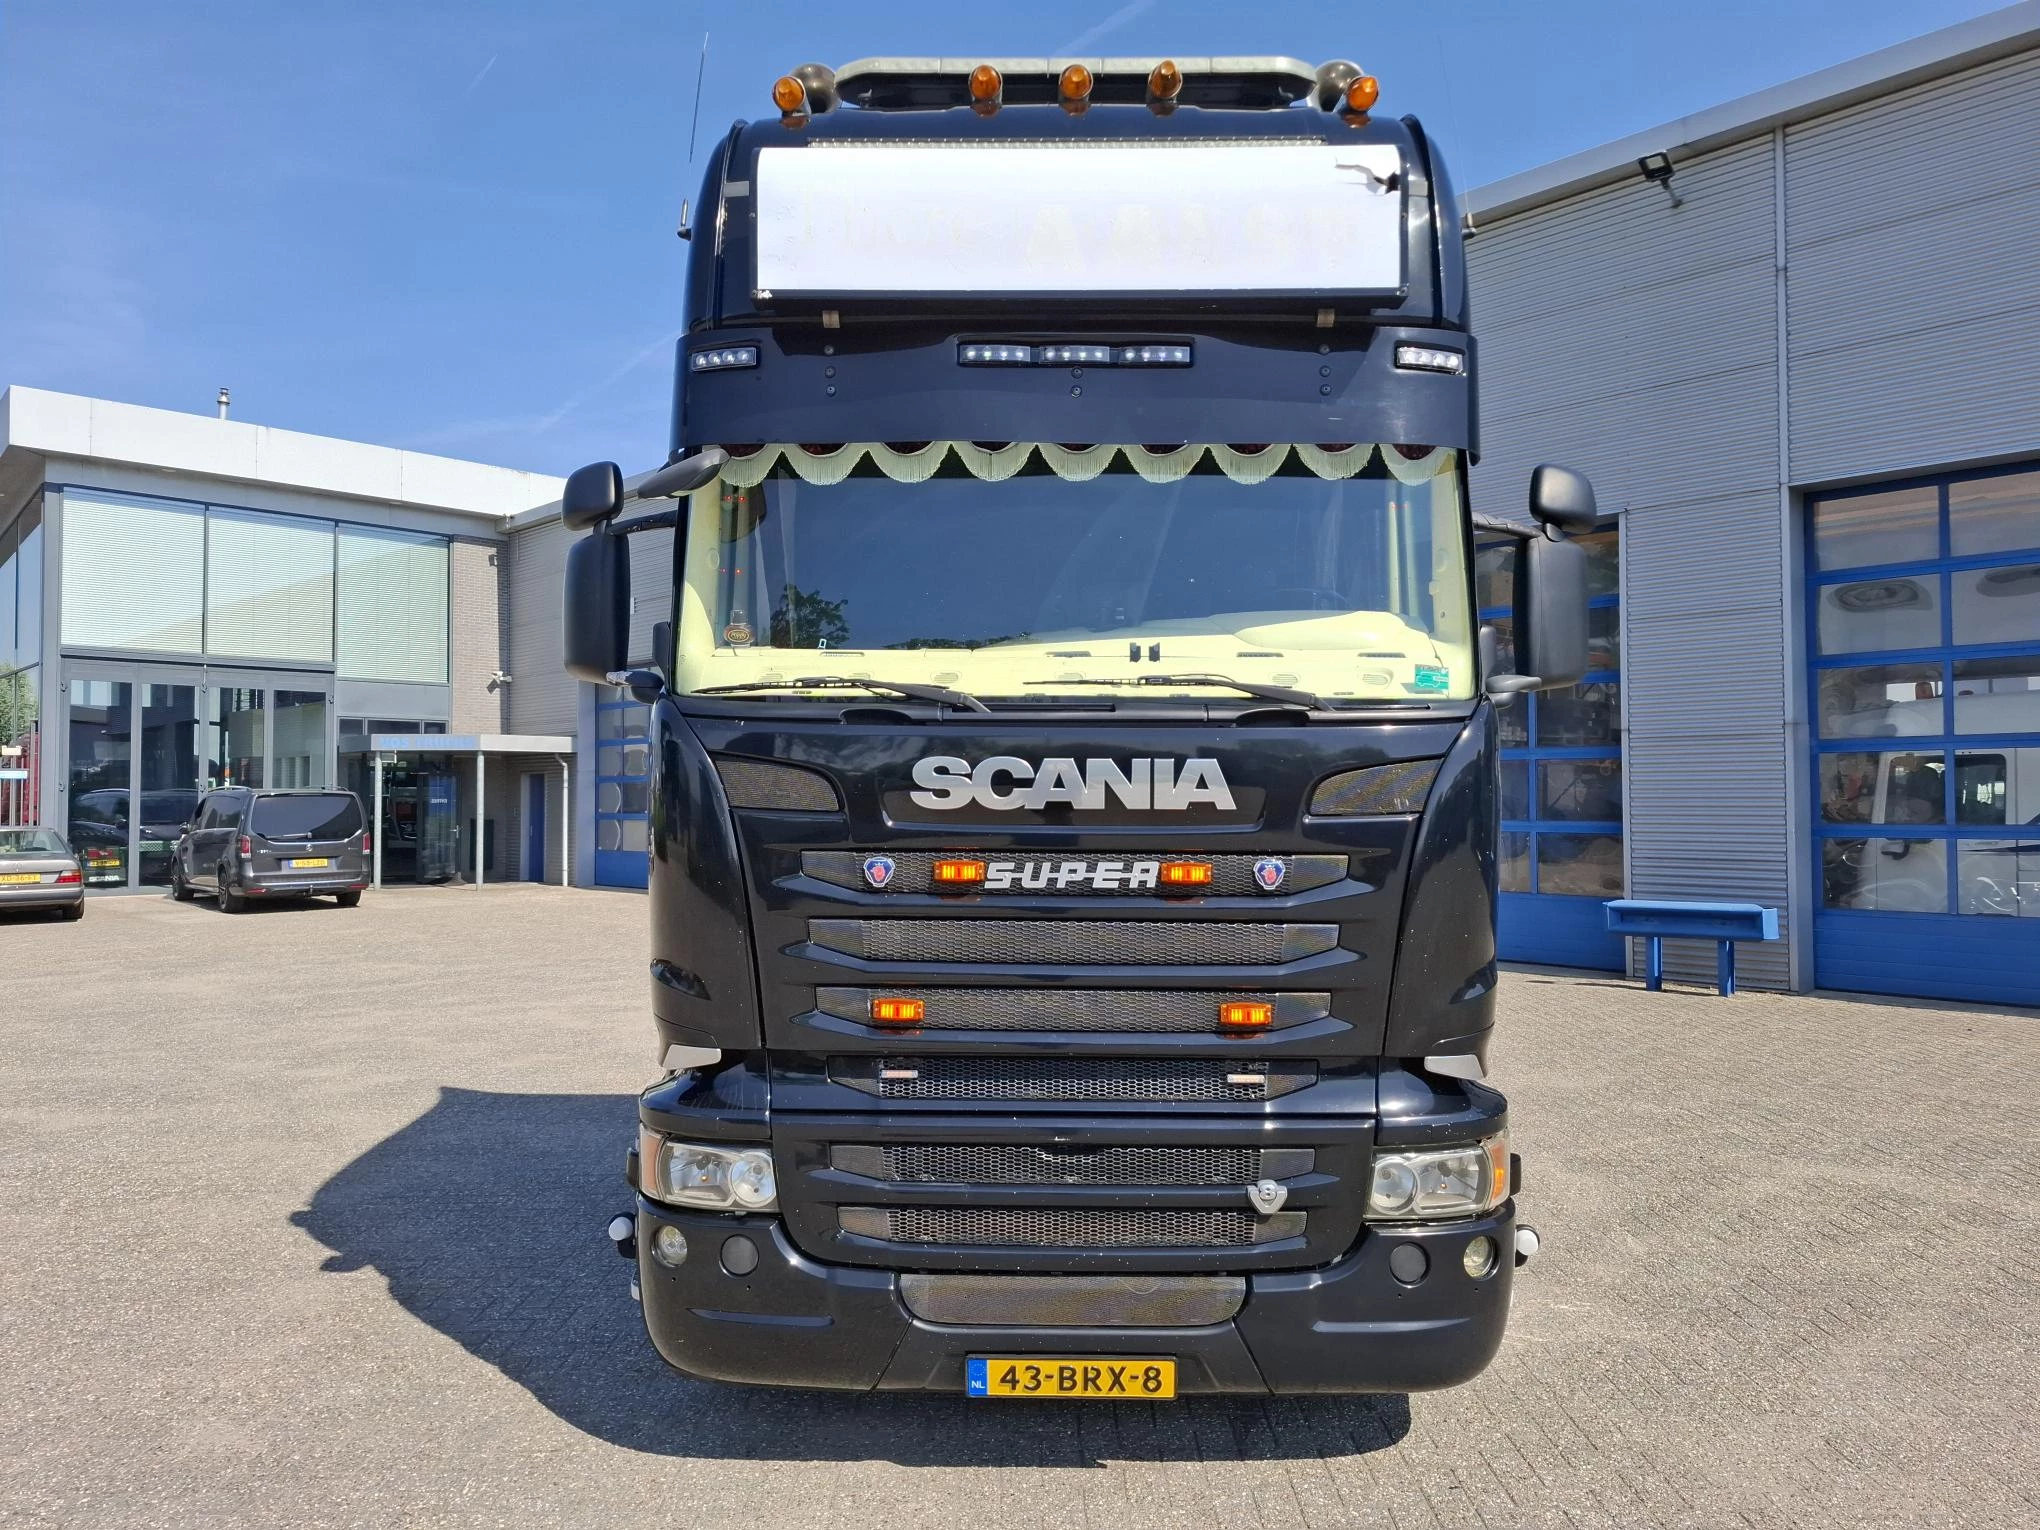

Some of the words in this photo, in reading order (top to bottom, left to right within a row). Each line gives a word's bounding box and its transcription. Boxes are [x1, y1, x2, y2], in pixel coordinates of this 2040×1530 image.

[909, 755, 1237, 811] SCANIA
[985, 861, 1161, 889] SUPER
[971, 1380, 985, 1389] NL
[1000, 1364, 1163, 1394] 43-BRX-8
